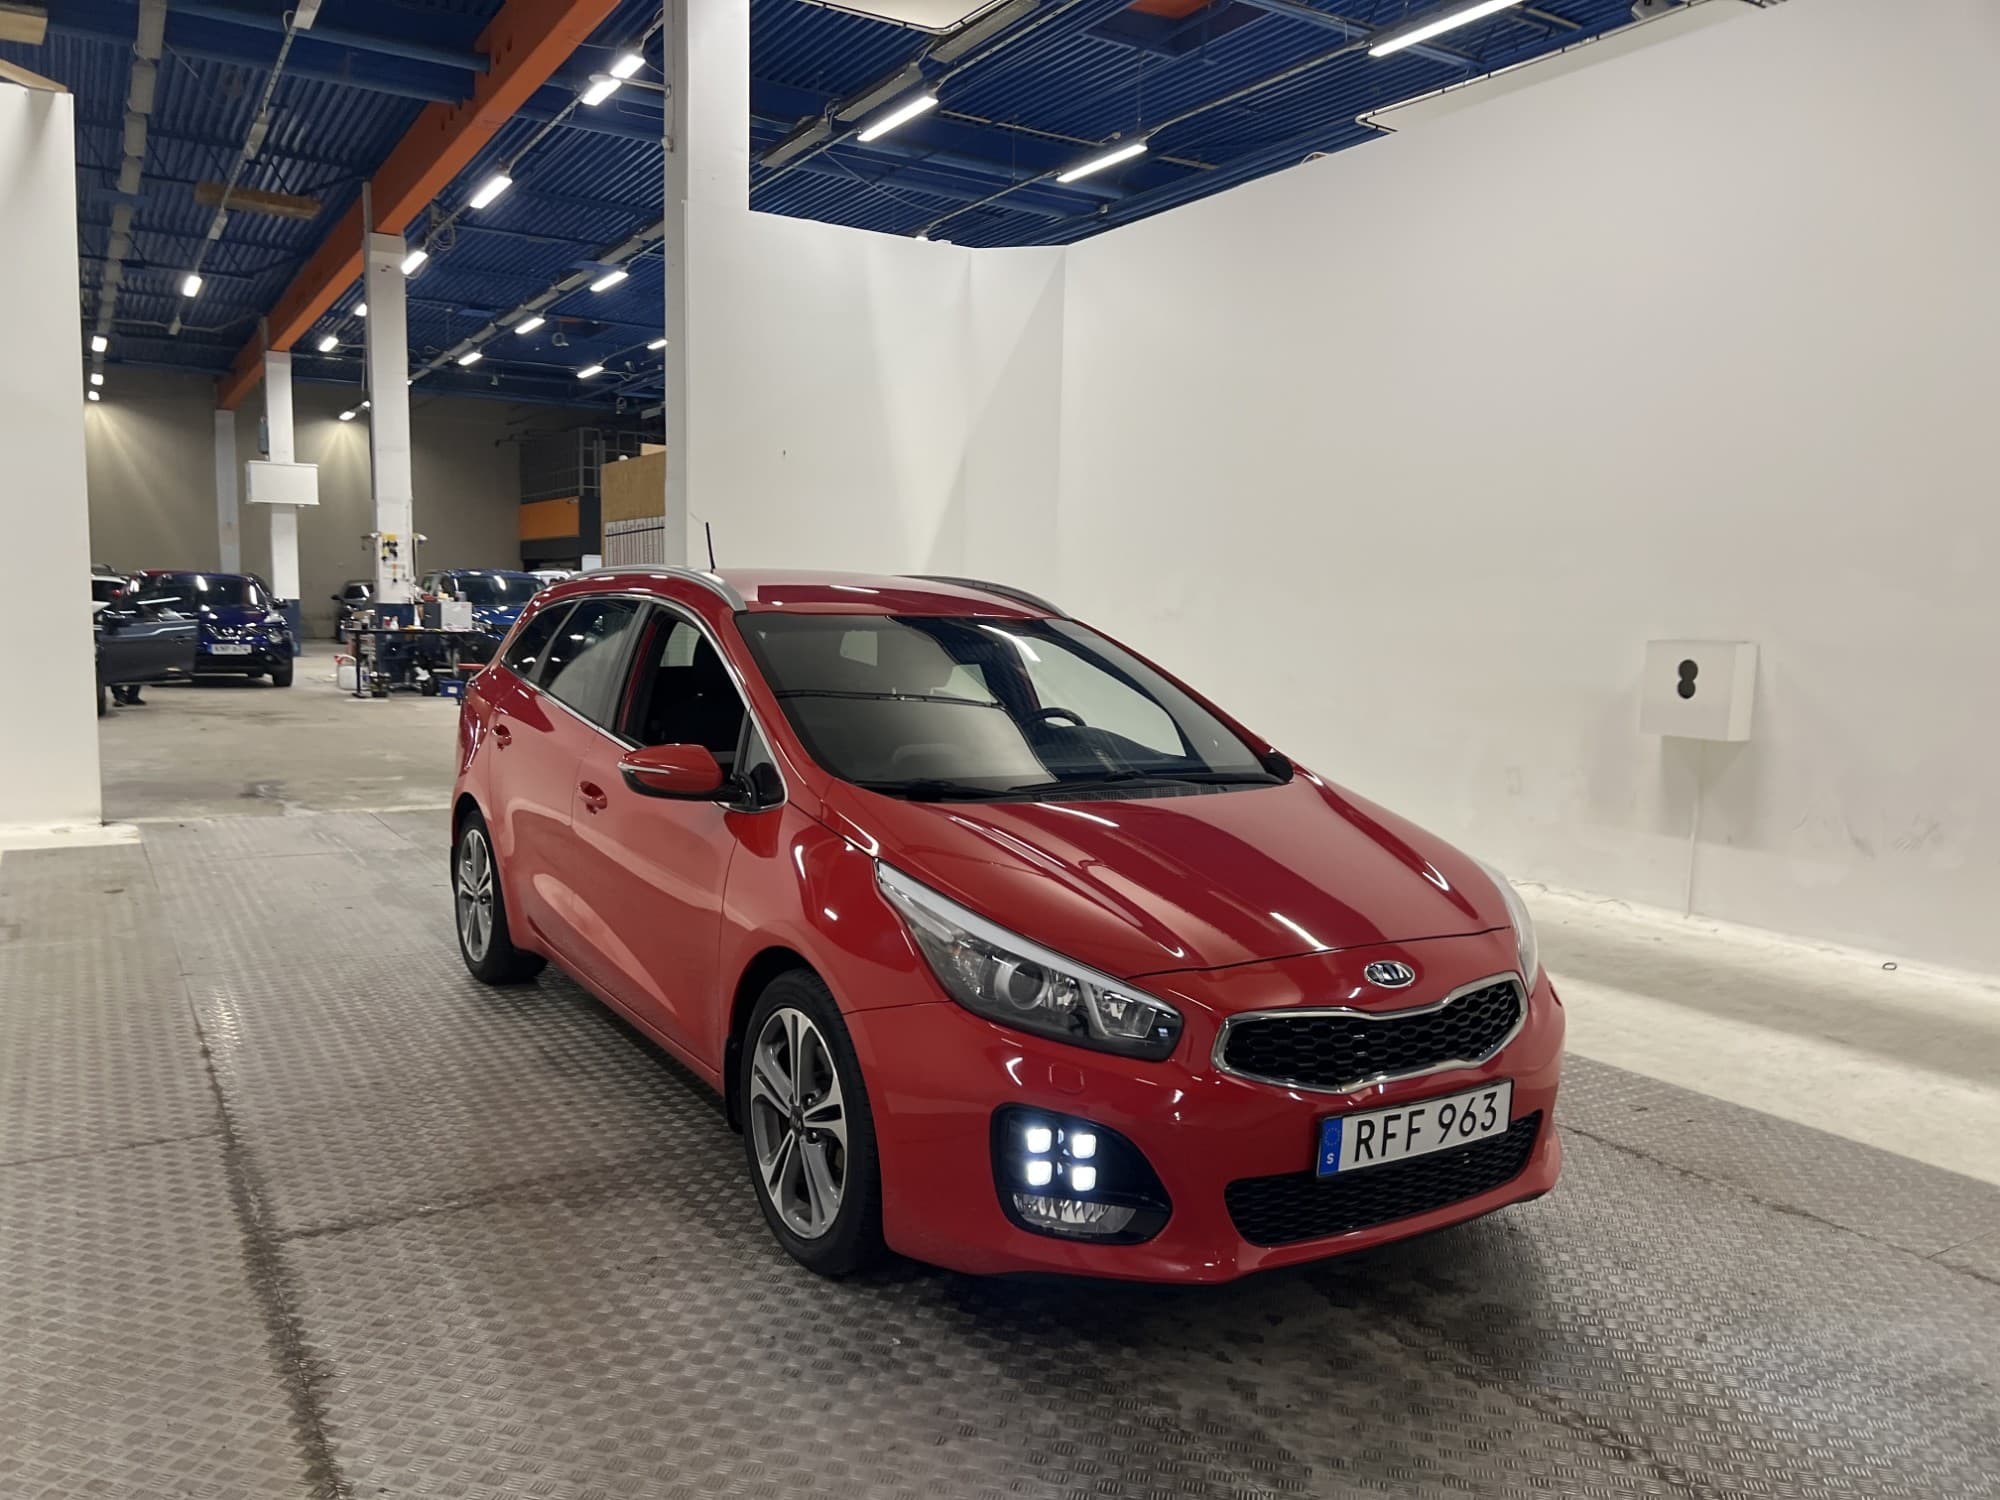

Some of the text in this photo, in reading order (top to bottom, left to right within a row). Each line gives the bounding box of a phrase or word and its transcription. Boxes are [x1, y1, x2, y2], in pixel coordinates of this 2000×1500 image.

[1355, 1092, 1497, 1162] RFF 963
[1326, 1152, 1335, 1164] S
